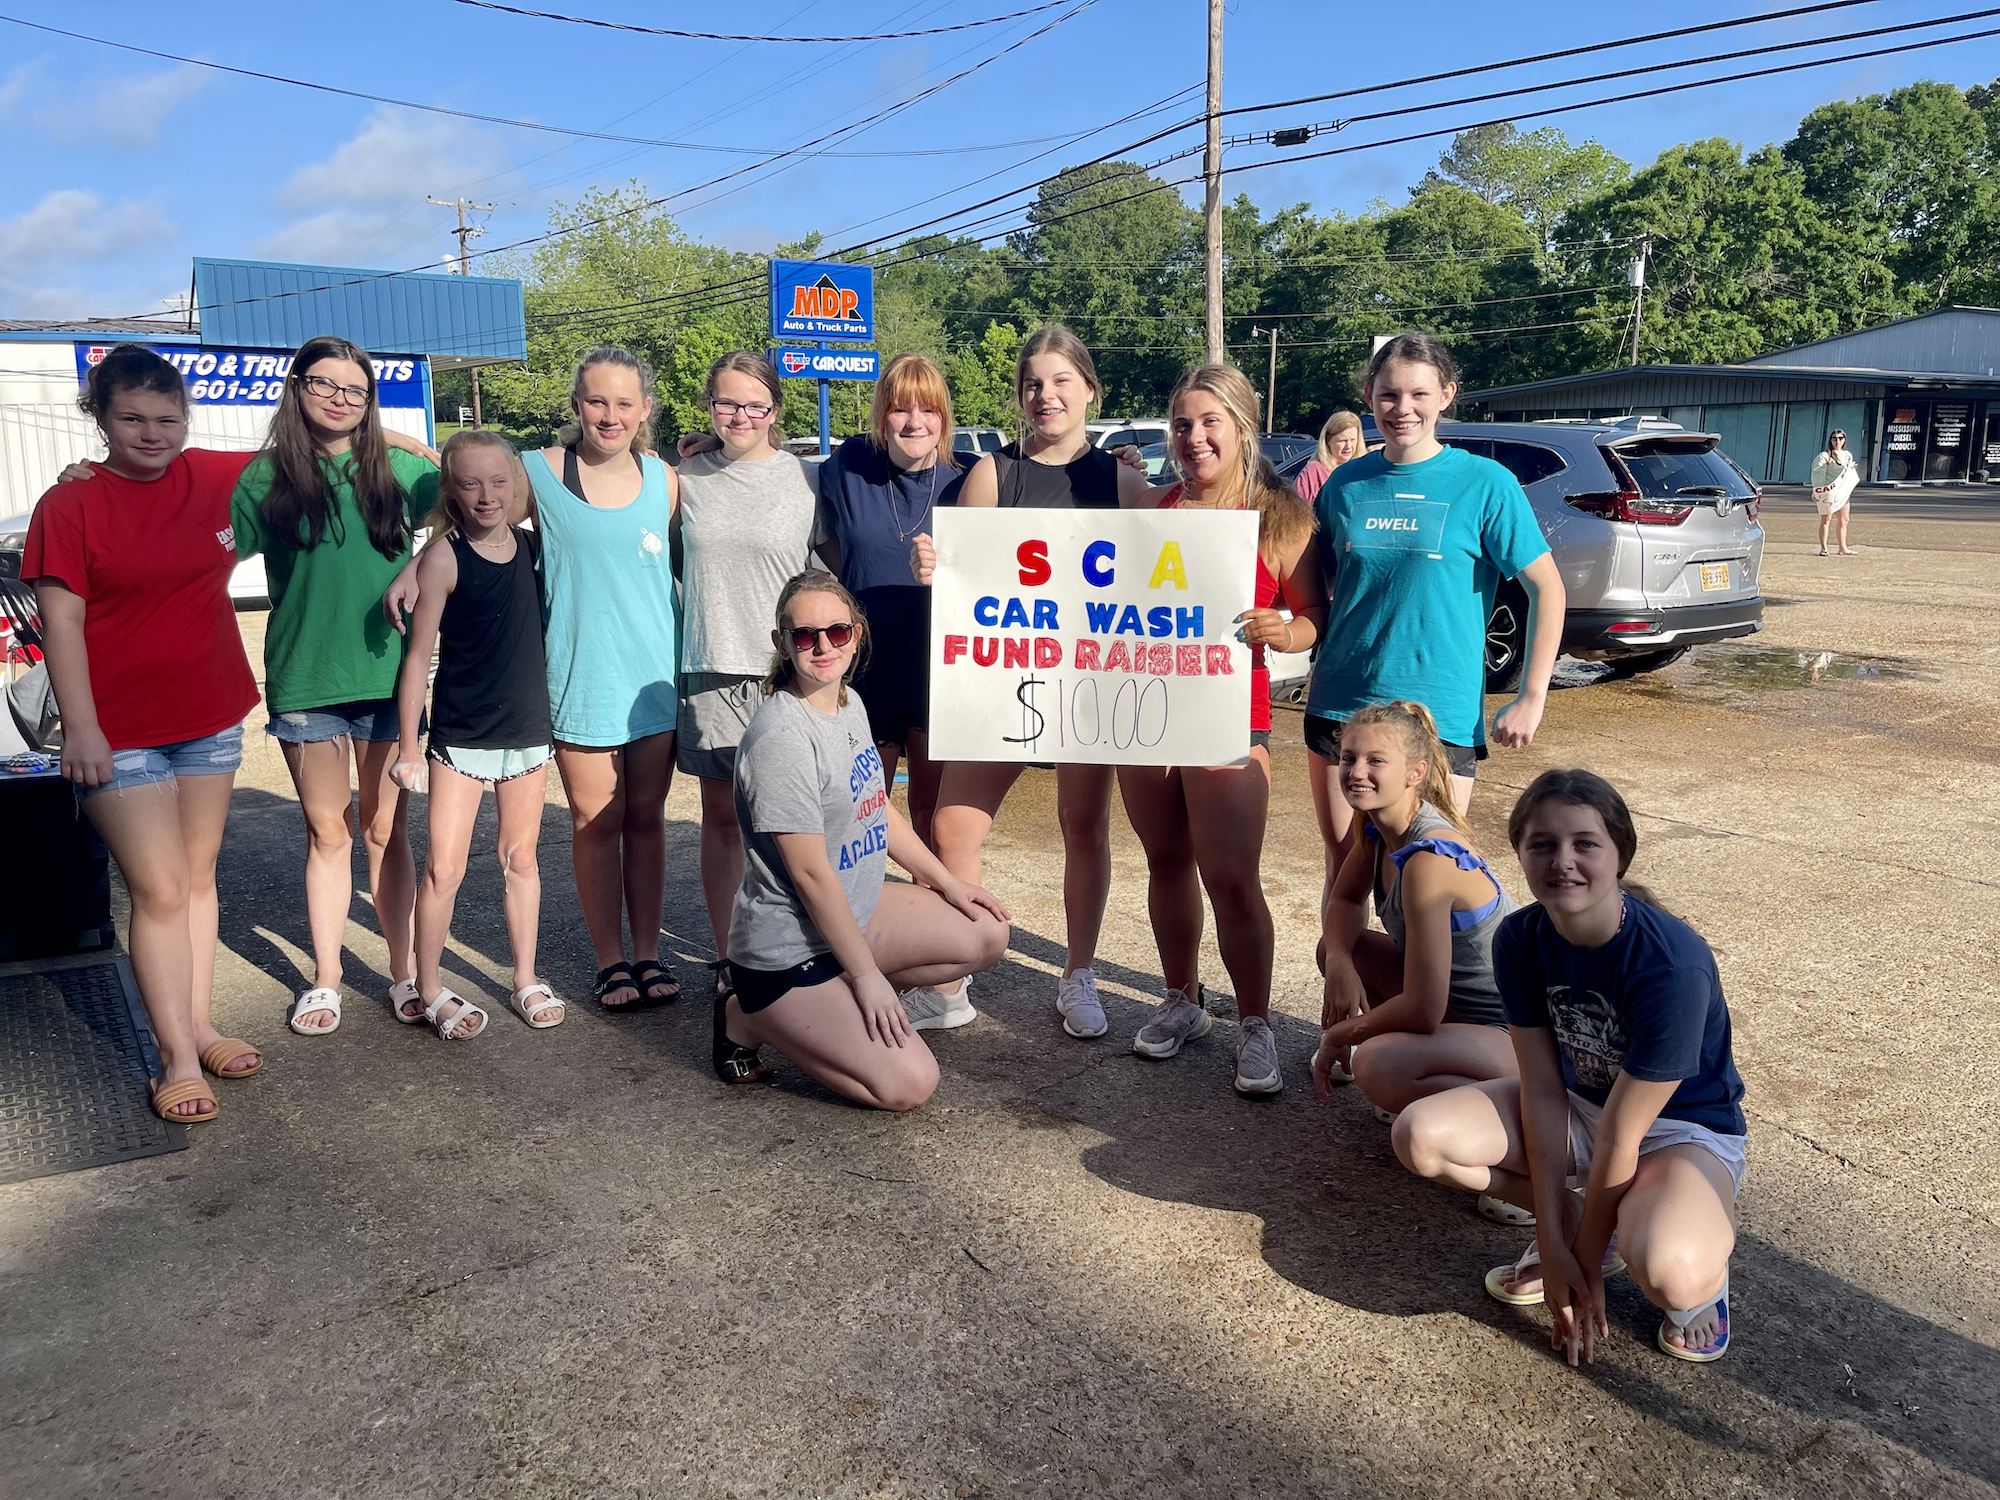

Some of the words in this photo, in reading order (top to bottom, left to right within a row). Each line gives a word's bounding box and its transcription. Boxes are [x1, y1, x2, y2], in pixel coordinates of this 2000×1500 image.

[794, 285, 858, 318] MDP
[783, 320, 805, 331] Auto
[806, 321, 814, 330] &
[816, 321, 842, 332] Truck
[843, 323, 867, 333] Parts
[218, 354, 238, 377] &
[242, 355, 295, 378] TRU
[370, 359, 414, 381] RTS
[812, 355, 875, 372] CARQUEST
[190, 379, 284, 401] 601-20
[1887, 424, 1921, 433] MISSISSIPPI
[1893, 433, 1912, 442] DIESEL
[1887, 442, 1917, 451] PRODUCTS
[1365, 517, 1419, 531] DWELL
[974, 596, 1059, 630] CAR
[1086, 601, 1204, 638] WASH
[943, 634, 1063, 669] FUND
[1074, 638, 1235, 676] RAISER
[1002, 672, 1168, 754] $10.00
